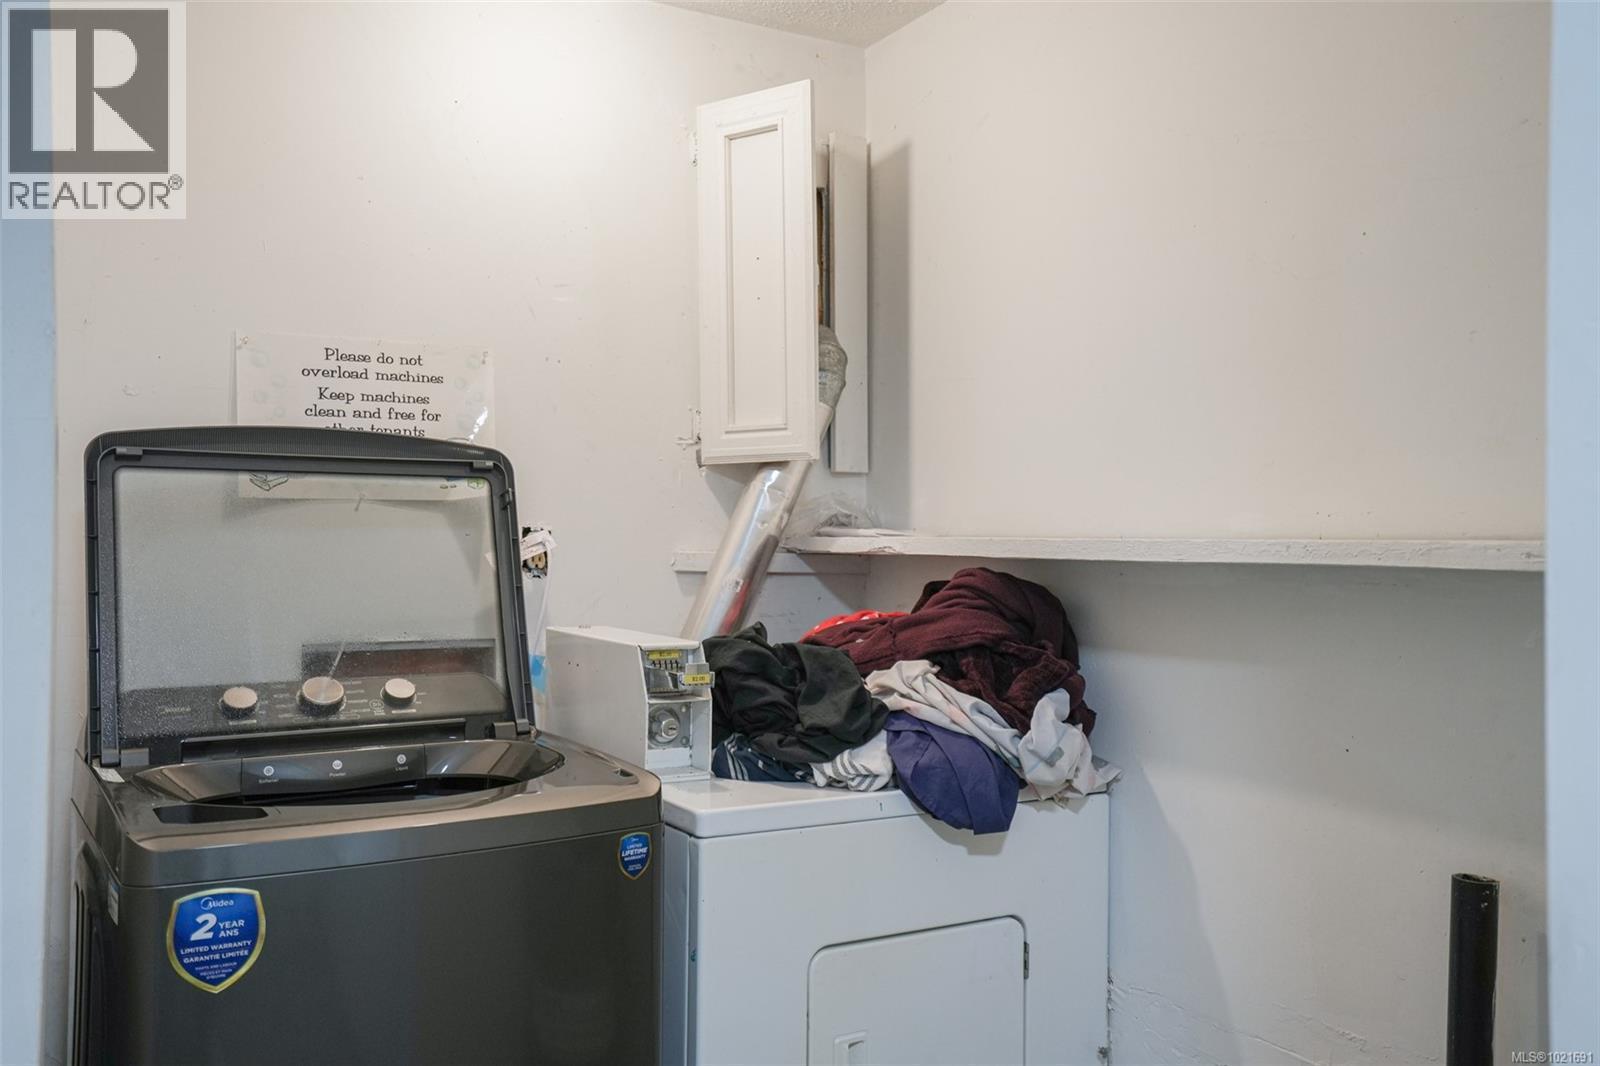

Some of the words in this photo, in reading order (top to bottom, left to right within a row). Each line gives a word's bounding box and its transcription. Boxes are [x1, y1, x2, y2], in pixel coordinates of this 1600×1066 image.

[324, 347, 371, 363] Please
[377, 351, 394, 365] do
[400, 353, 423, 366] not
[301, 366, 368, 381] overload
[375, 370, 444, 385] machines
[318, 387, 355, 404] Keep
[361, 390, 430, 405] machines
[304, 403, 346, 419] clean
[352, 406, 381, 420] and
[387, 408, 415, 421] free
[421, 409, 442, 422] for
[621, 846, 648, 857] LIFETIME
[200, 897, 234, 910] Midea
[190, 913, 217, 941] 2
[218, 919, 245, 929] YEAR
[219, 929, 239, 938] ANS
[180, 945, 209, 955] LIMITED
[210, 940, 252, 951] WARRANTY
[183, 953, 220, 964] GARANTIE
